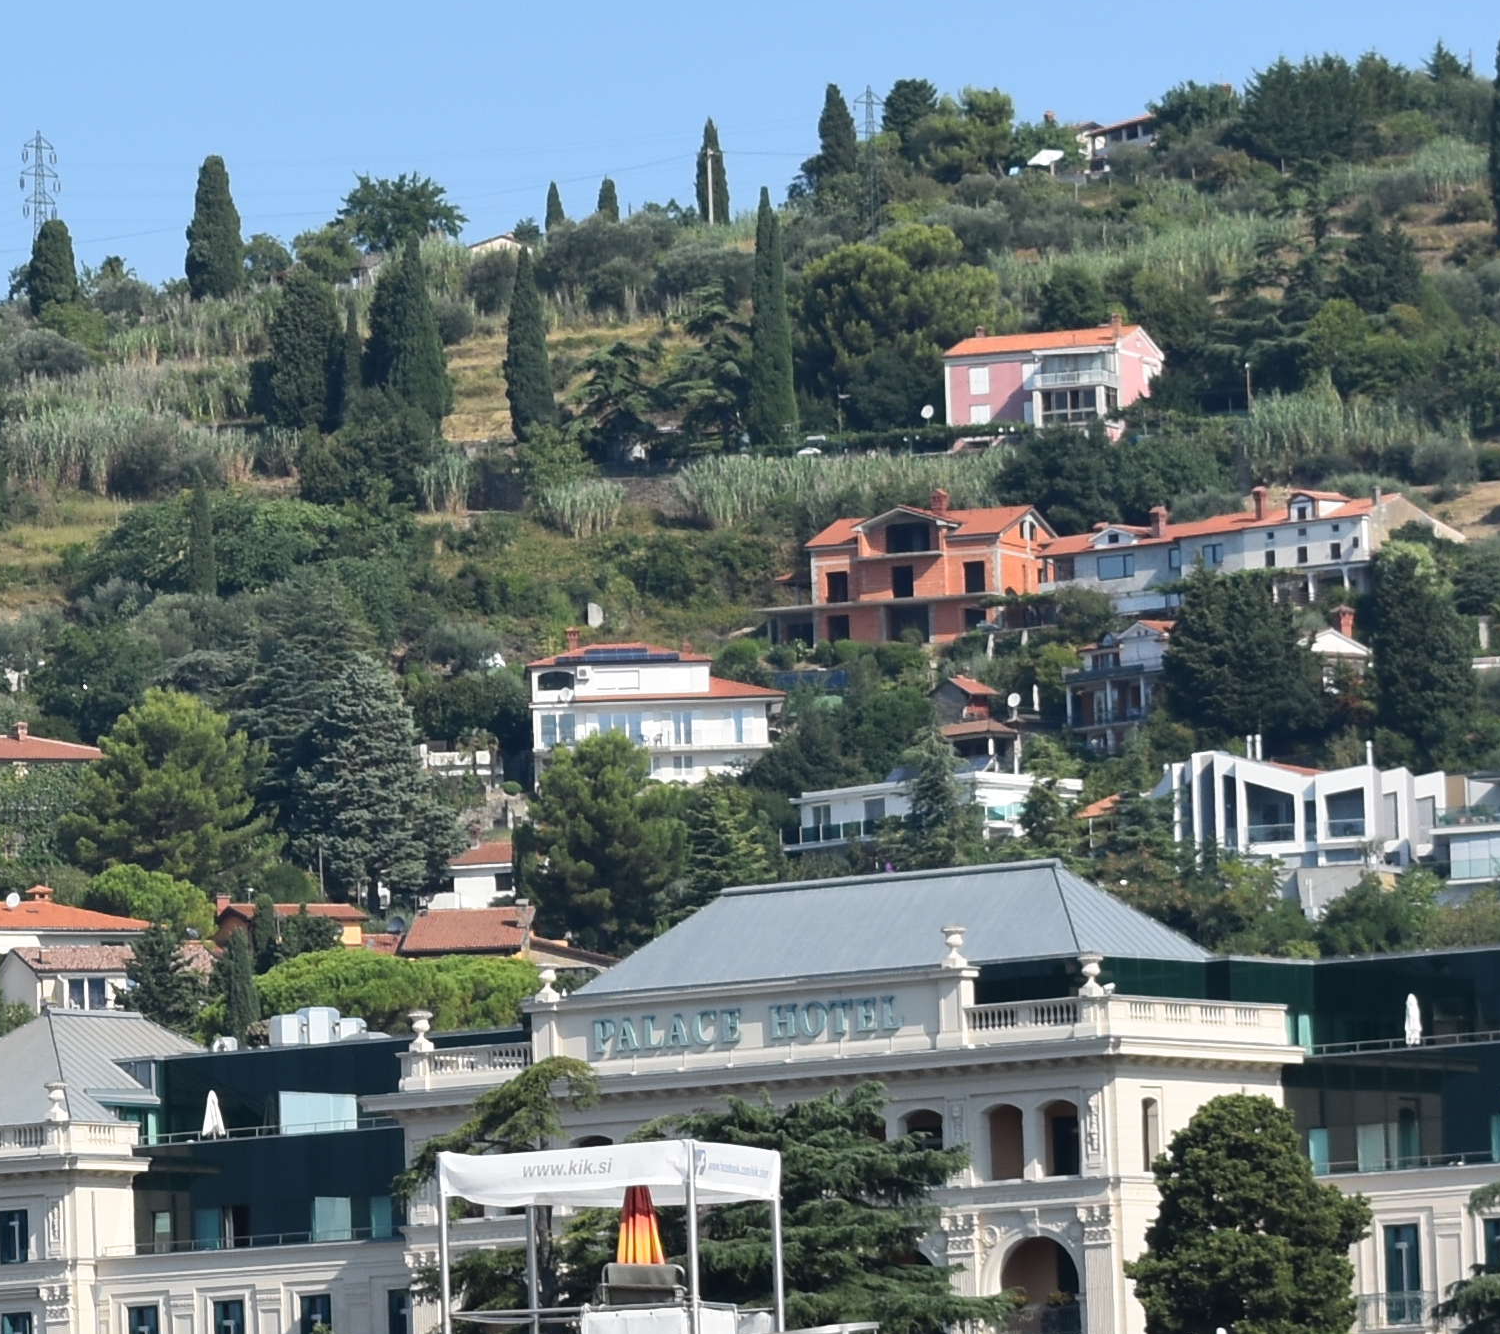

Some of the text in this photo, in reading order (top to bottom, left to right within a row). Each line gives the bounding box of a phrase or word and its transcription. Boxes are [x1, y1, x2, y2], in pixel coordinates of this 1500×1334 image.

[593, 995, 904, 1054] PALACE HOTEL
[522, 1157, 613, 1178] www.kik.si
